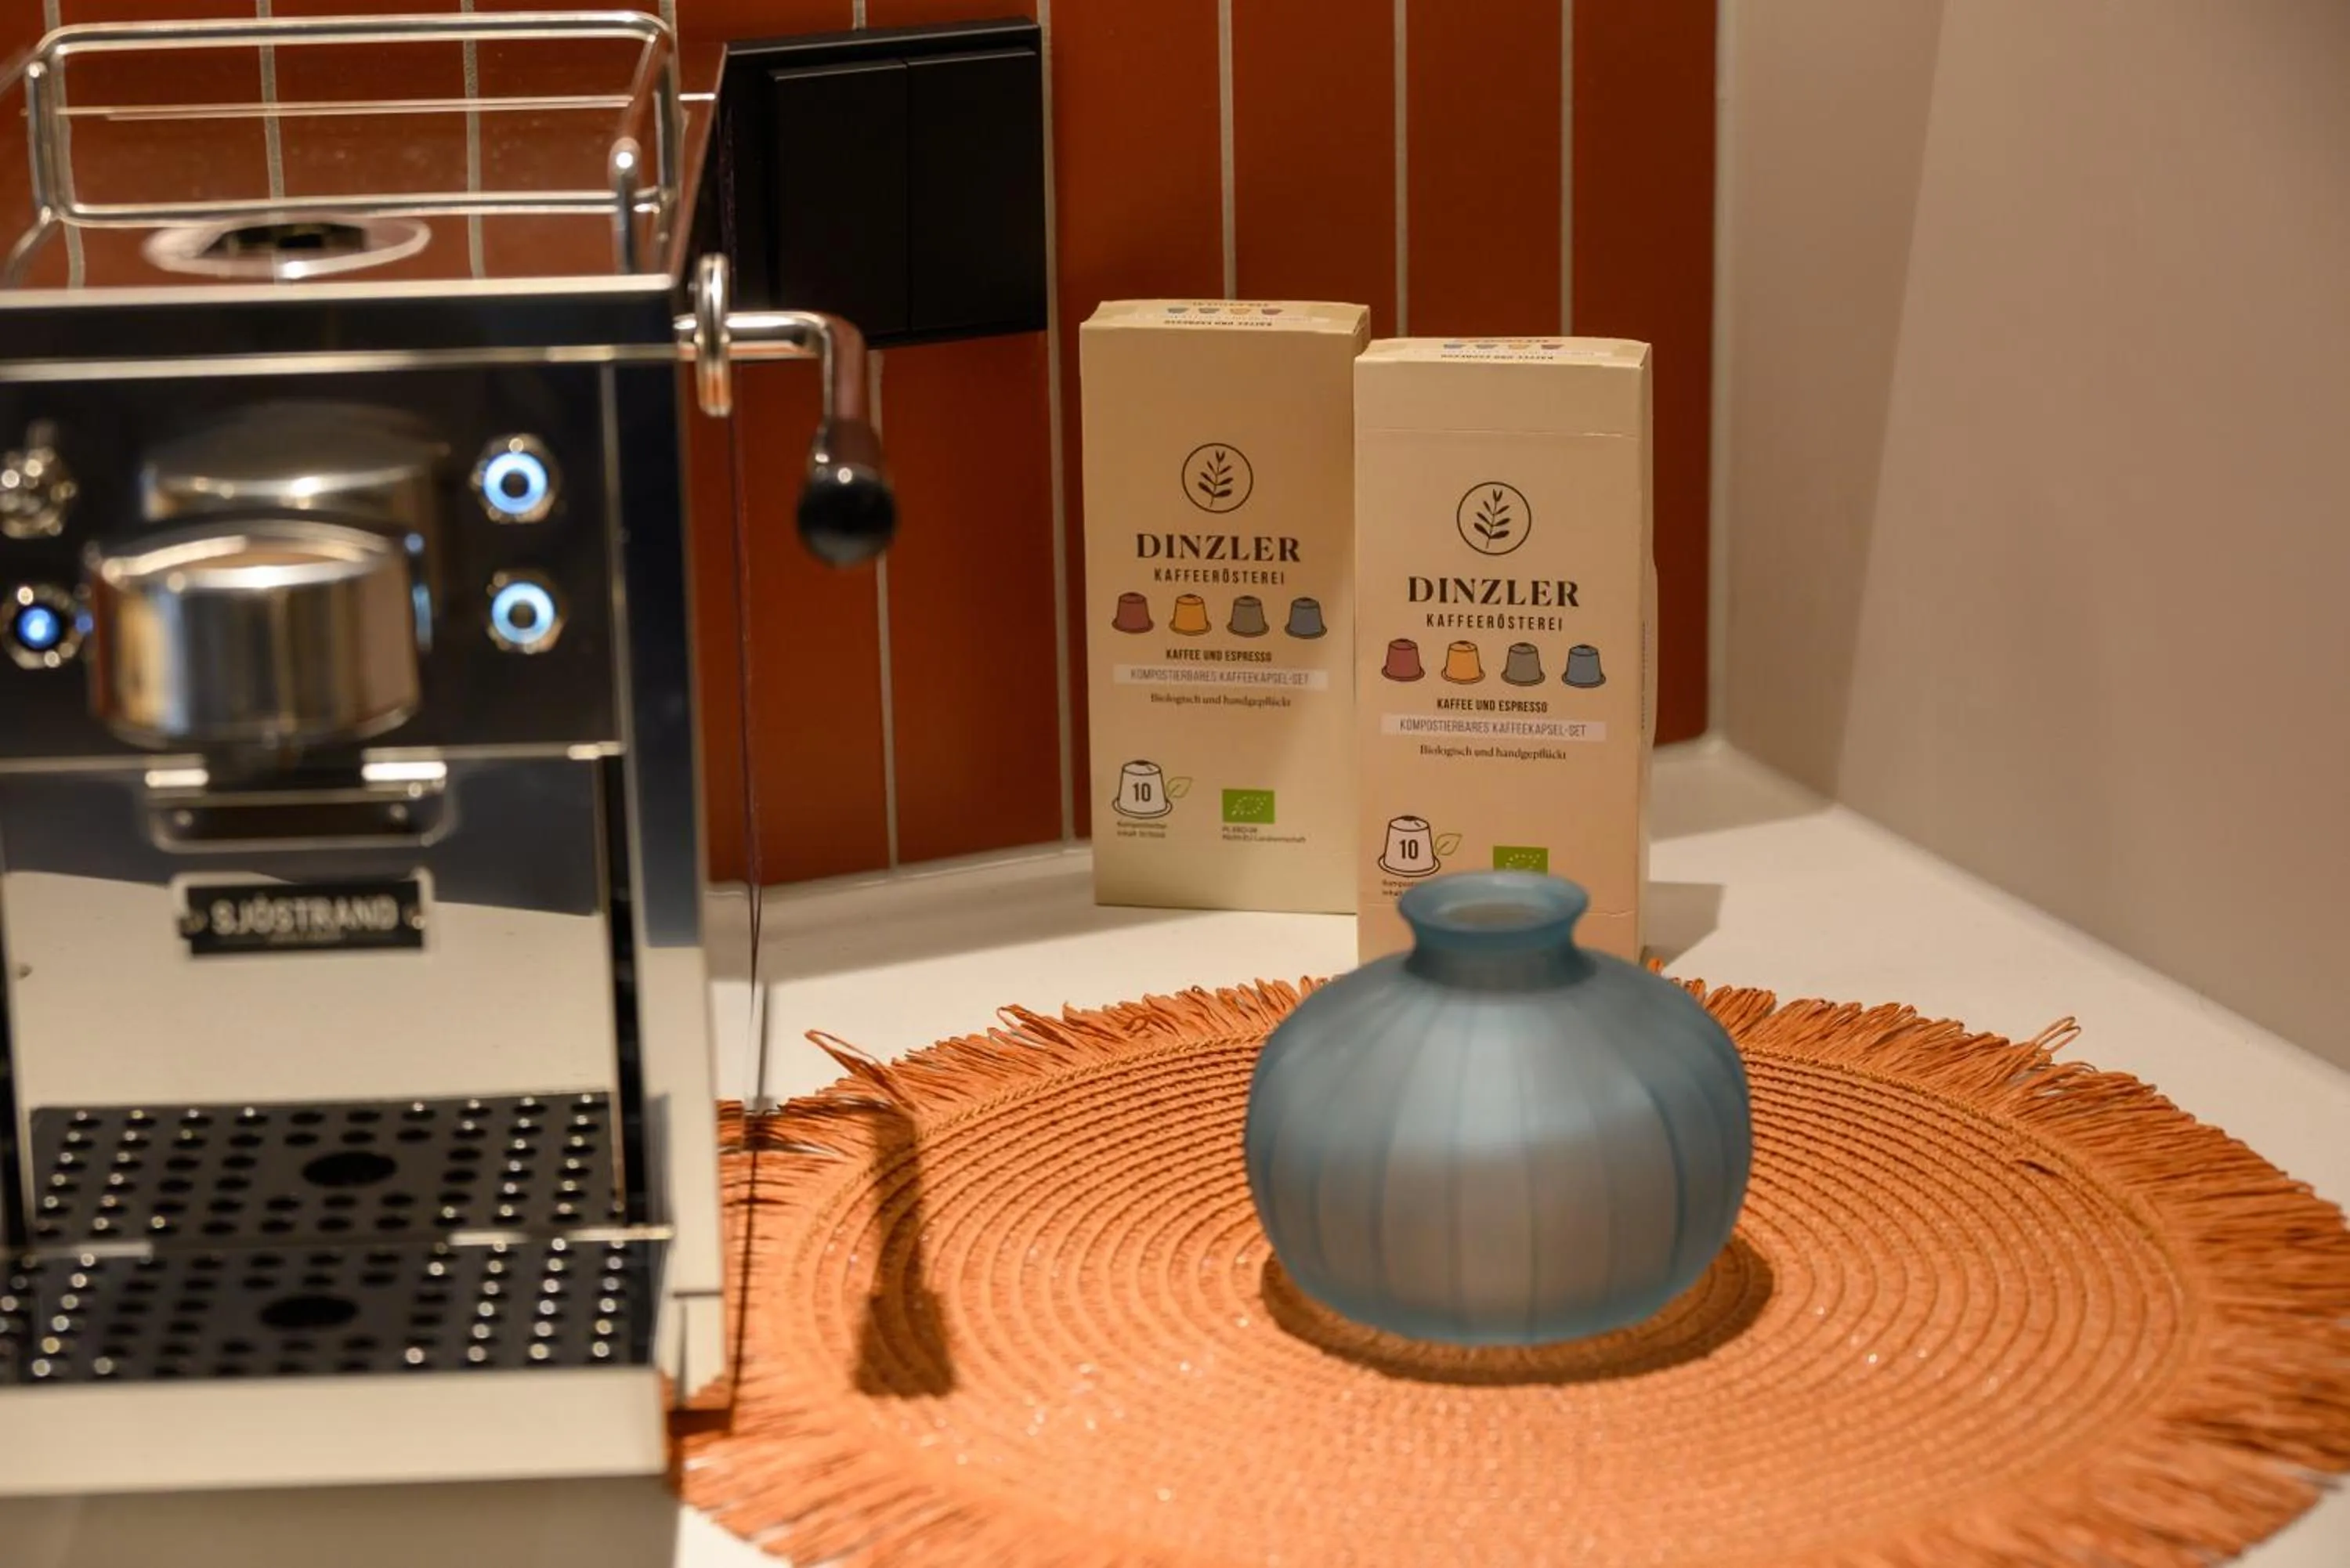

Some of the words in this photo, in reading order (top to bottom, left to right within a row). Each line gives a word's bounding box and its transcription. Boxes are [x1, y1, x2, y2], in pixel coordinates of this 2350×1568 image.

[1136, 533, 1301, 562] DINZLER
[1154, 567, 1285, 586] KAFFEERÖSTEREI
[1408, 576, 1580, 607] DINZLER
[1426, 613, 1563, 631] KAFFEERÖSTEREI
[1166, 649, 1201, 661] KAFFEE
[1203, 650, 1222, 661] UND
[1224, 650, 1272, 663] ESPRESSO
[1202, 695, 1221, 705] und
[1437, 698, 1473, 710] KAFFEE
[1476, 699, 1495, 711] UND
[1499, 700, 1549, 713] ESPRESSO
[1400, 718, 1489, 733] KOMPOSTIERBARES
[1492, 721, 1587, 737] KAFFEEKAPSEL-SET
[1419, 745, 1472, 757] Biologisch
[1474, 746, 1494, 757] und
[1495, 747, 1567, 760] handgepflückt
[1133, 782, 1151, 802] 10
[1399, 839, 1419, 859] 10
[211, 894, 398, 934] SJÖSTRAND
